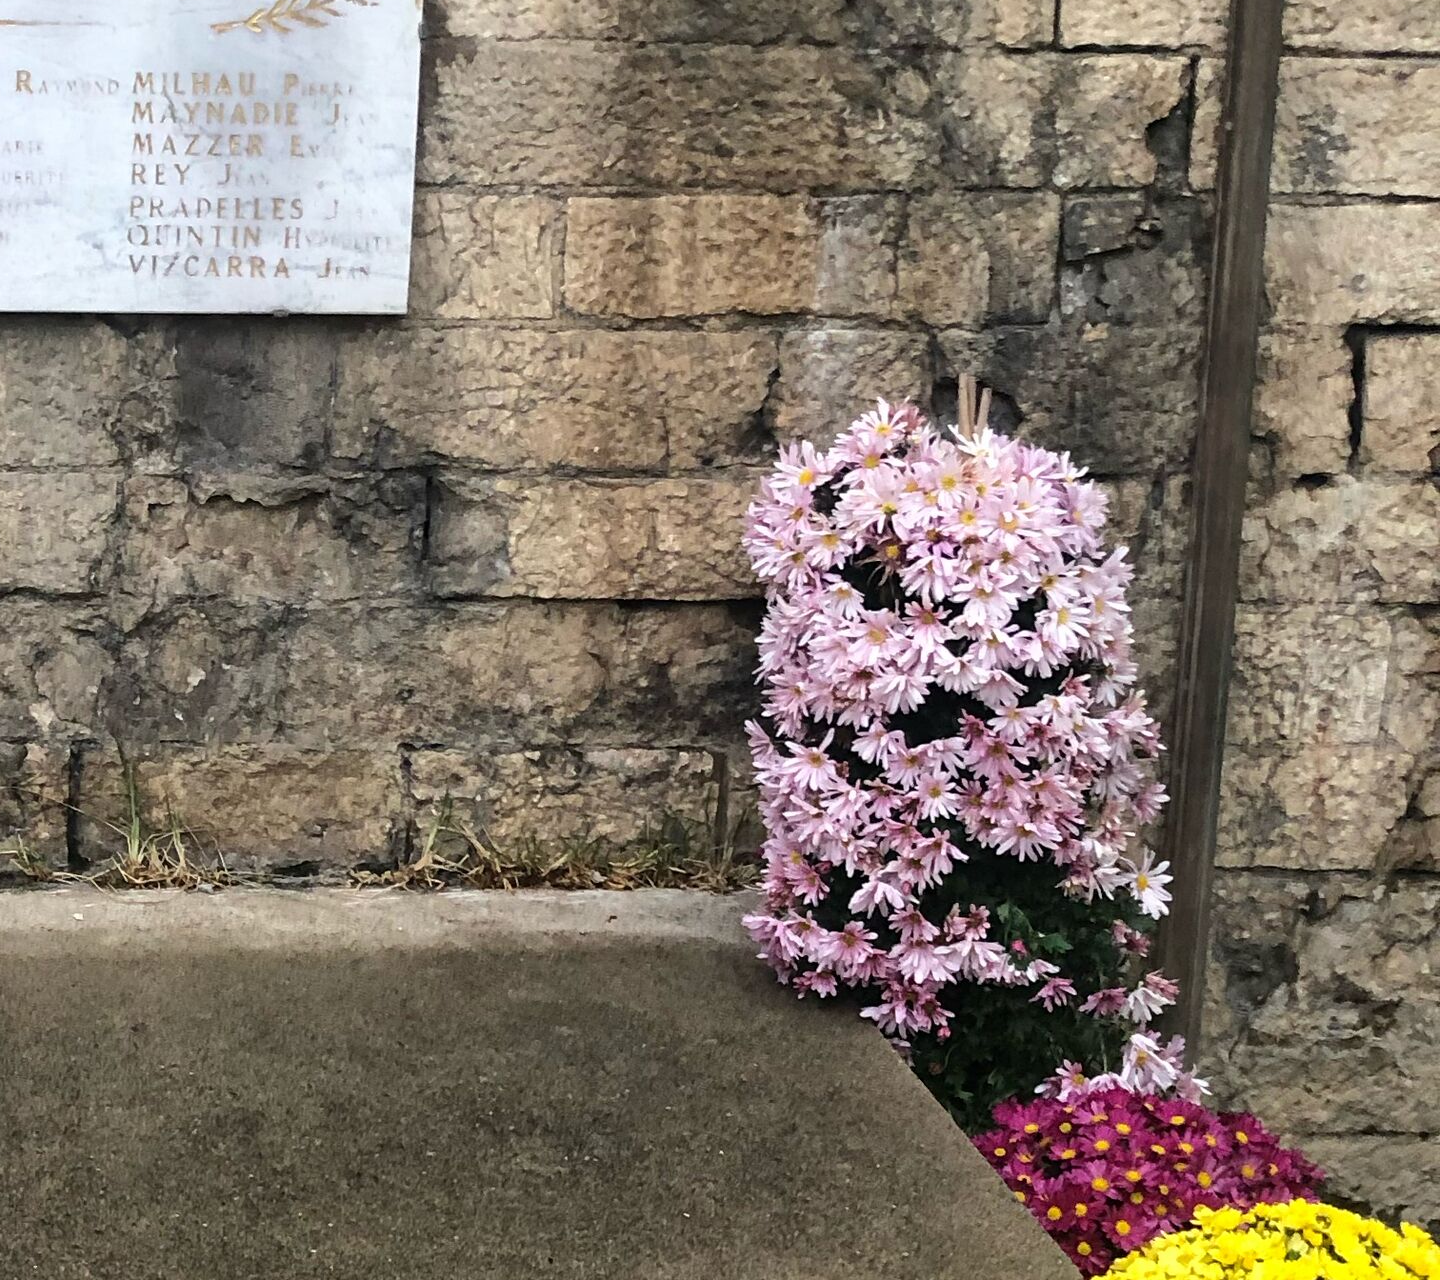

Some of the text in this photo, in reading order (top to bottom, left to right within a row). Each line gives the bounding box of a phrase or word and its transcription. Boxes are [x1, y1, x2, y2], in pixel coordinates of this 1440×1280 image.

[132, 71, 257, 96] MILHAU
[131, 102, 299, 126] MAYNADIE
[132, 133, 265, 157] MAZZER
[130, 163, 191, 186] REY
[129, 196, 304, 221] PRADELLES
[126, 225, 261, 249] QUINTIN
[128, 255, 291, 279] VIZCARRA
